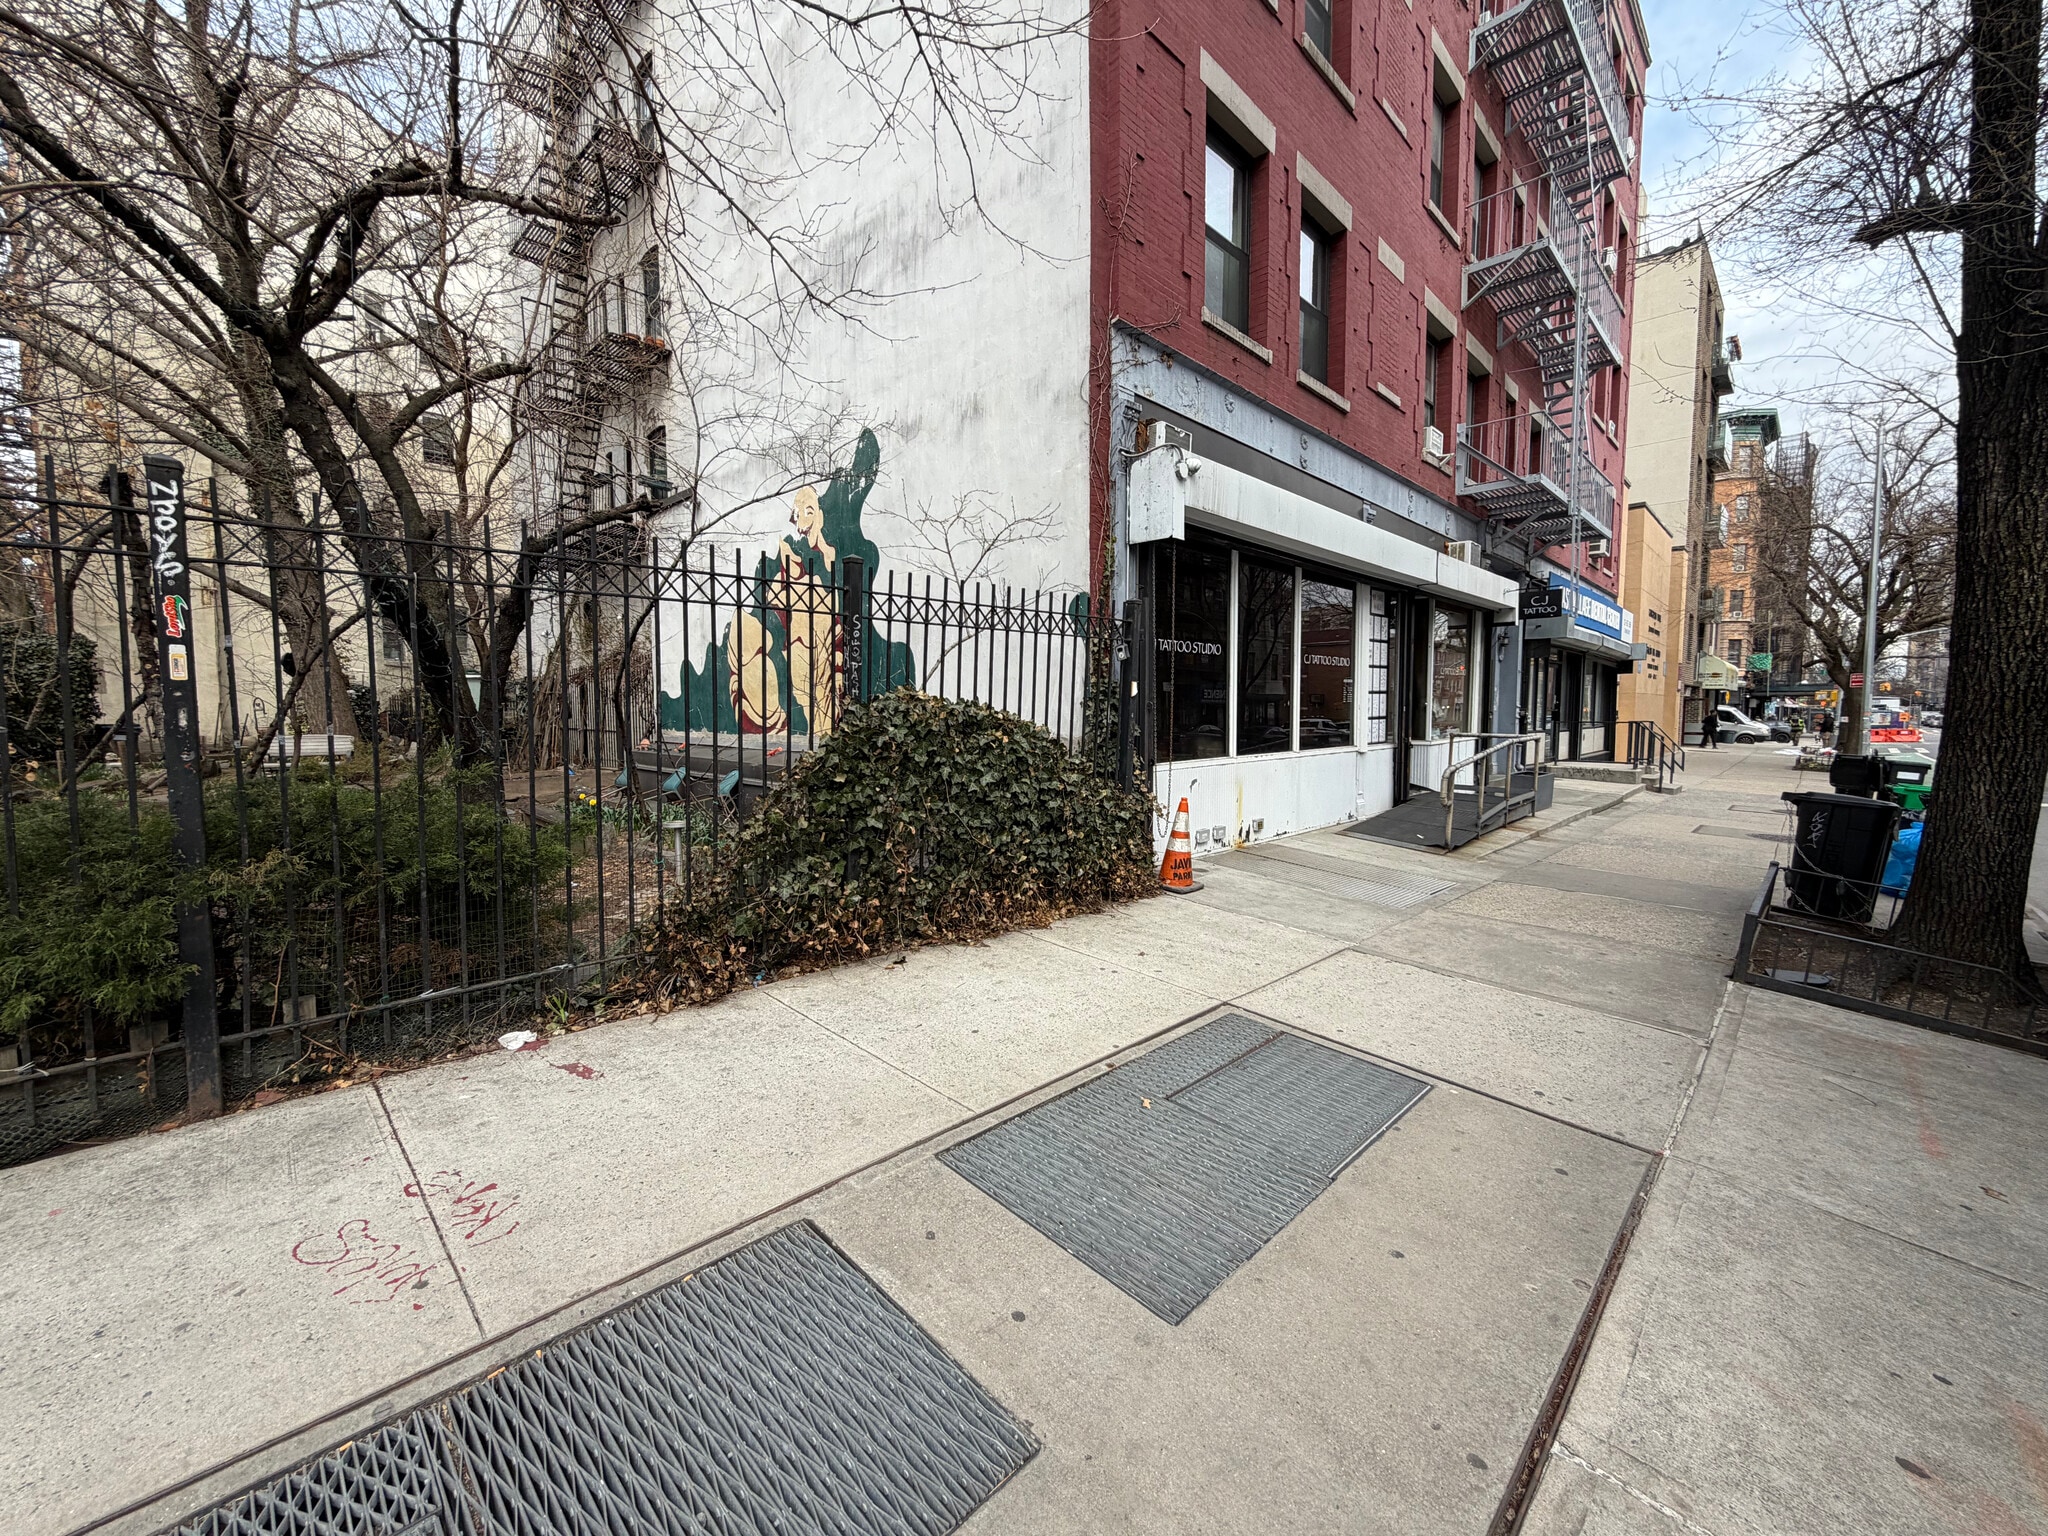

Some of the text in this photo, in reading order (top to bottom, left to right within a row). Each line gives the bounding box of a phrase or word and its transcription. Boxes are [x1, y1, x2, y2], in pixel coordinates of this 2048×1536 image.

[1530, 595, 1549, 606] CJ
[1522, 605, 1557, 615] TATTOO
[1158, 638, 1192, 653] TATTOO
[1192, 641, 1222, 656] STUDIO
[1303, 654, 1351, 667] CJ TATTOO STUDIO
